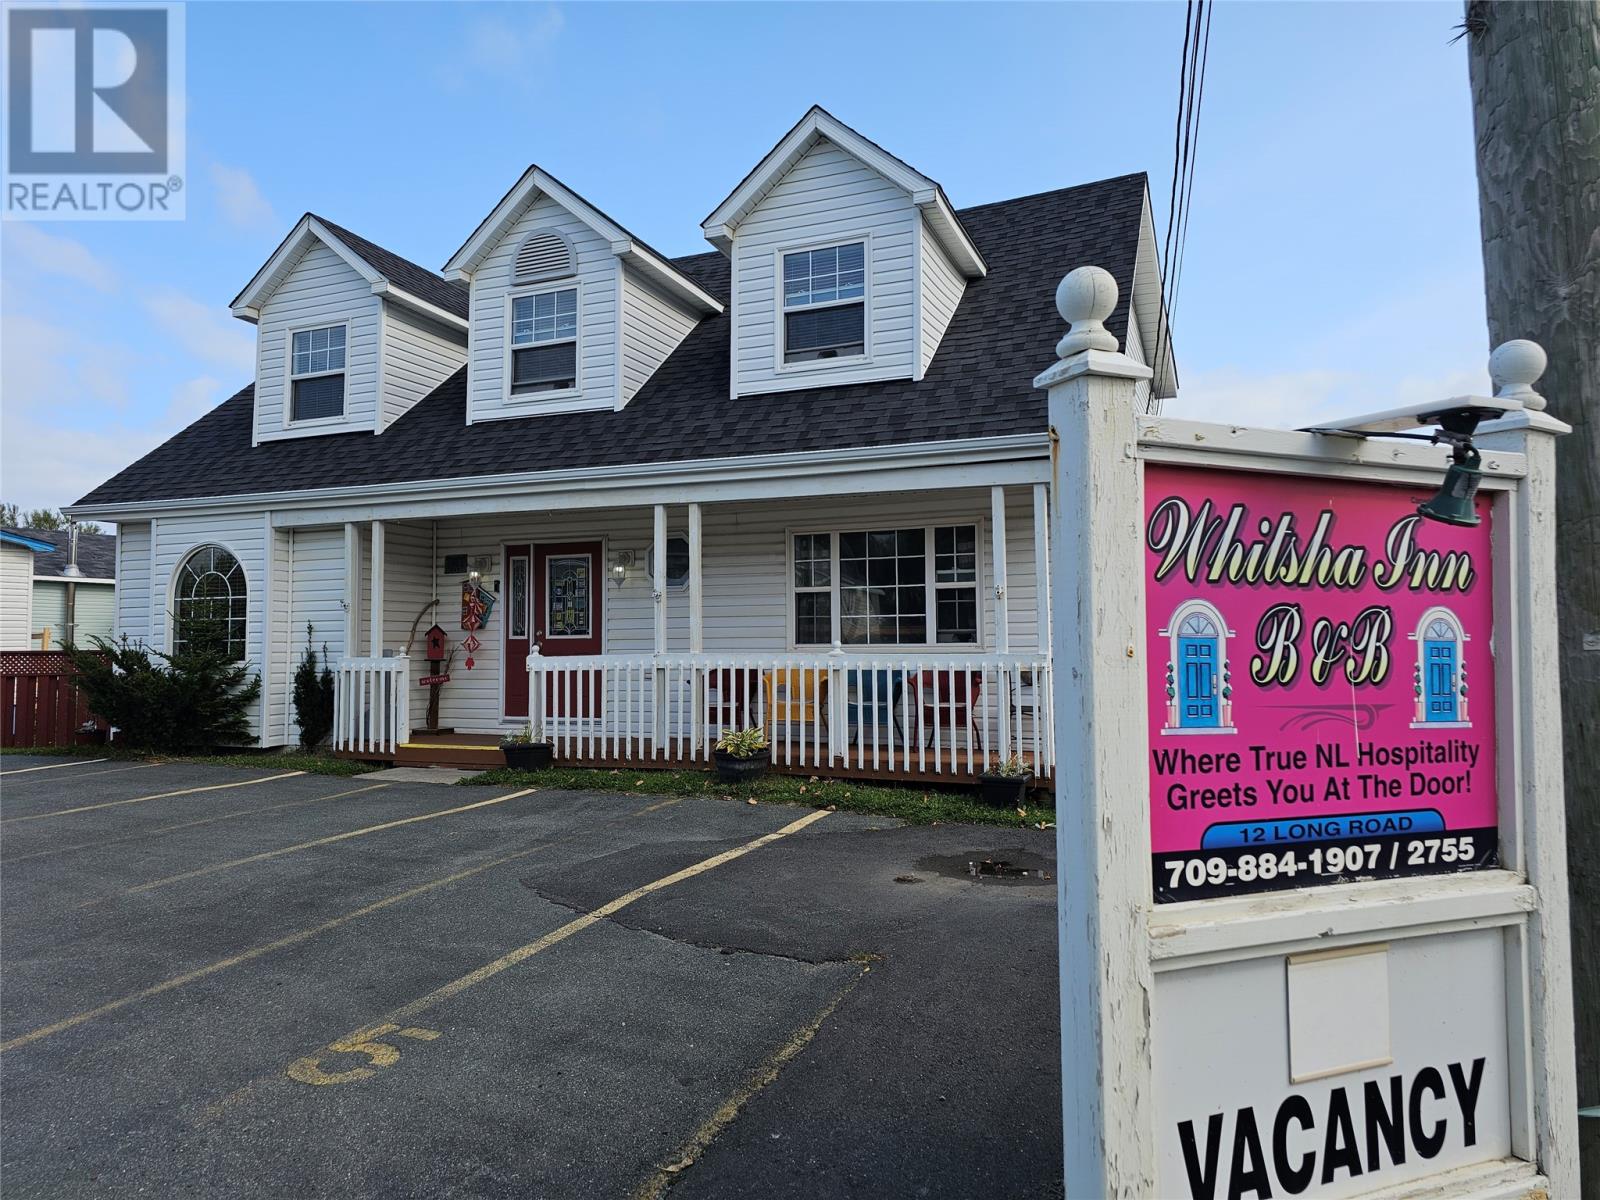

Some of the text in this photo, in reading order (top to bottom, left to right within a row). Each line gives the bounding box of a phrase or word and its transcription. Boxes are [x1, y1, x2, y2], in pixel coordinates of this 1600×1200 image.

[1147, 495, 1475, 591] Whitsha Inn
[1153, 739, 1480, 775] Where True NL Hospitality
[1166, 770, 1472, 811] Greets You At The Door!
[1240, 815, 1413, 843] 12 LONG ROAD
[1164, 844, 1380, 888] 709-884-1907
[1407, 836, 1475, 865] 2755
[1177, 1057, 1486, 1200] VACANCY
